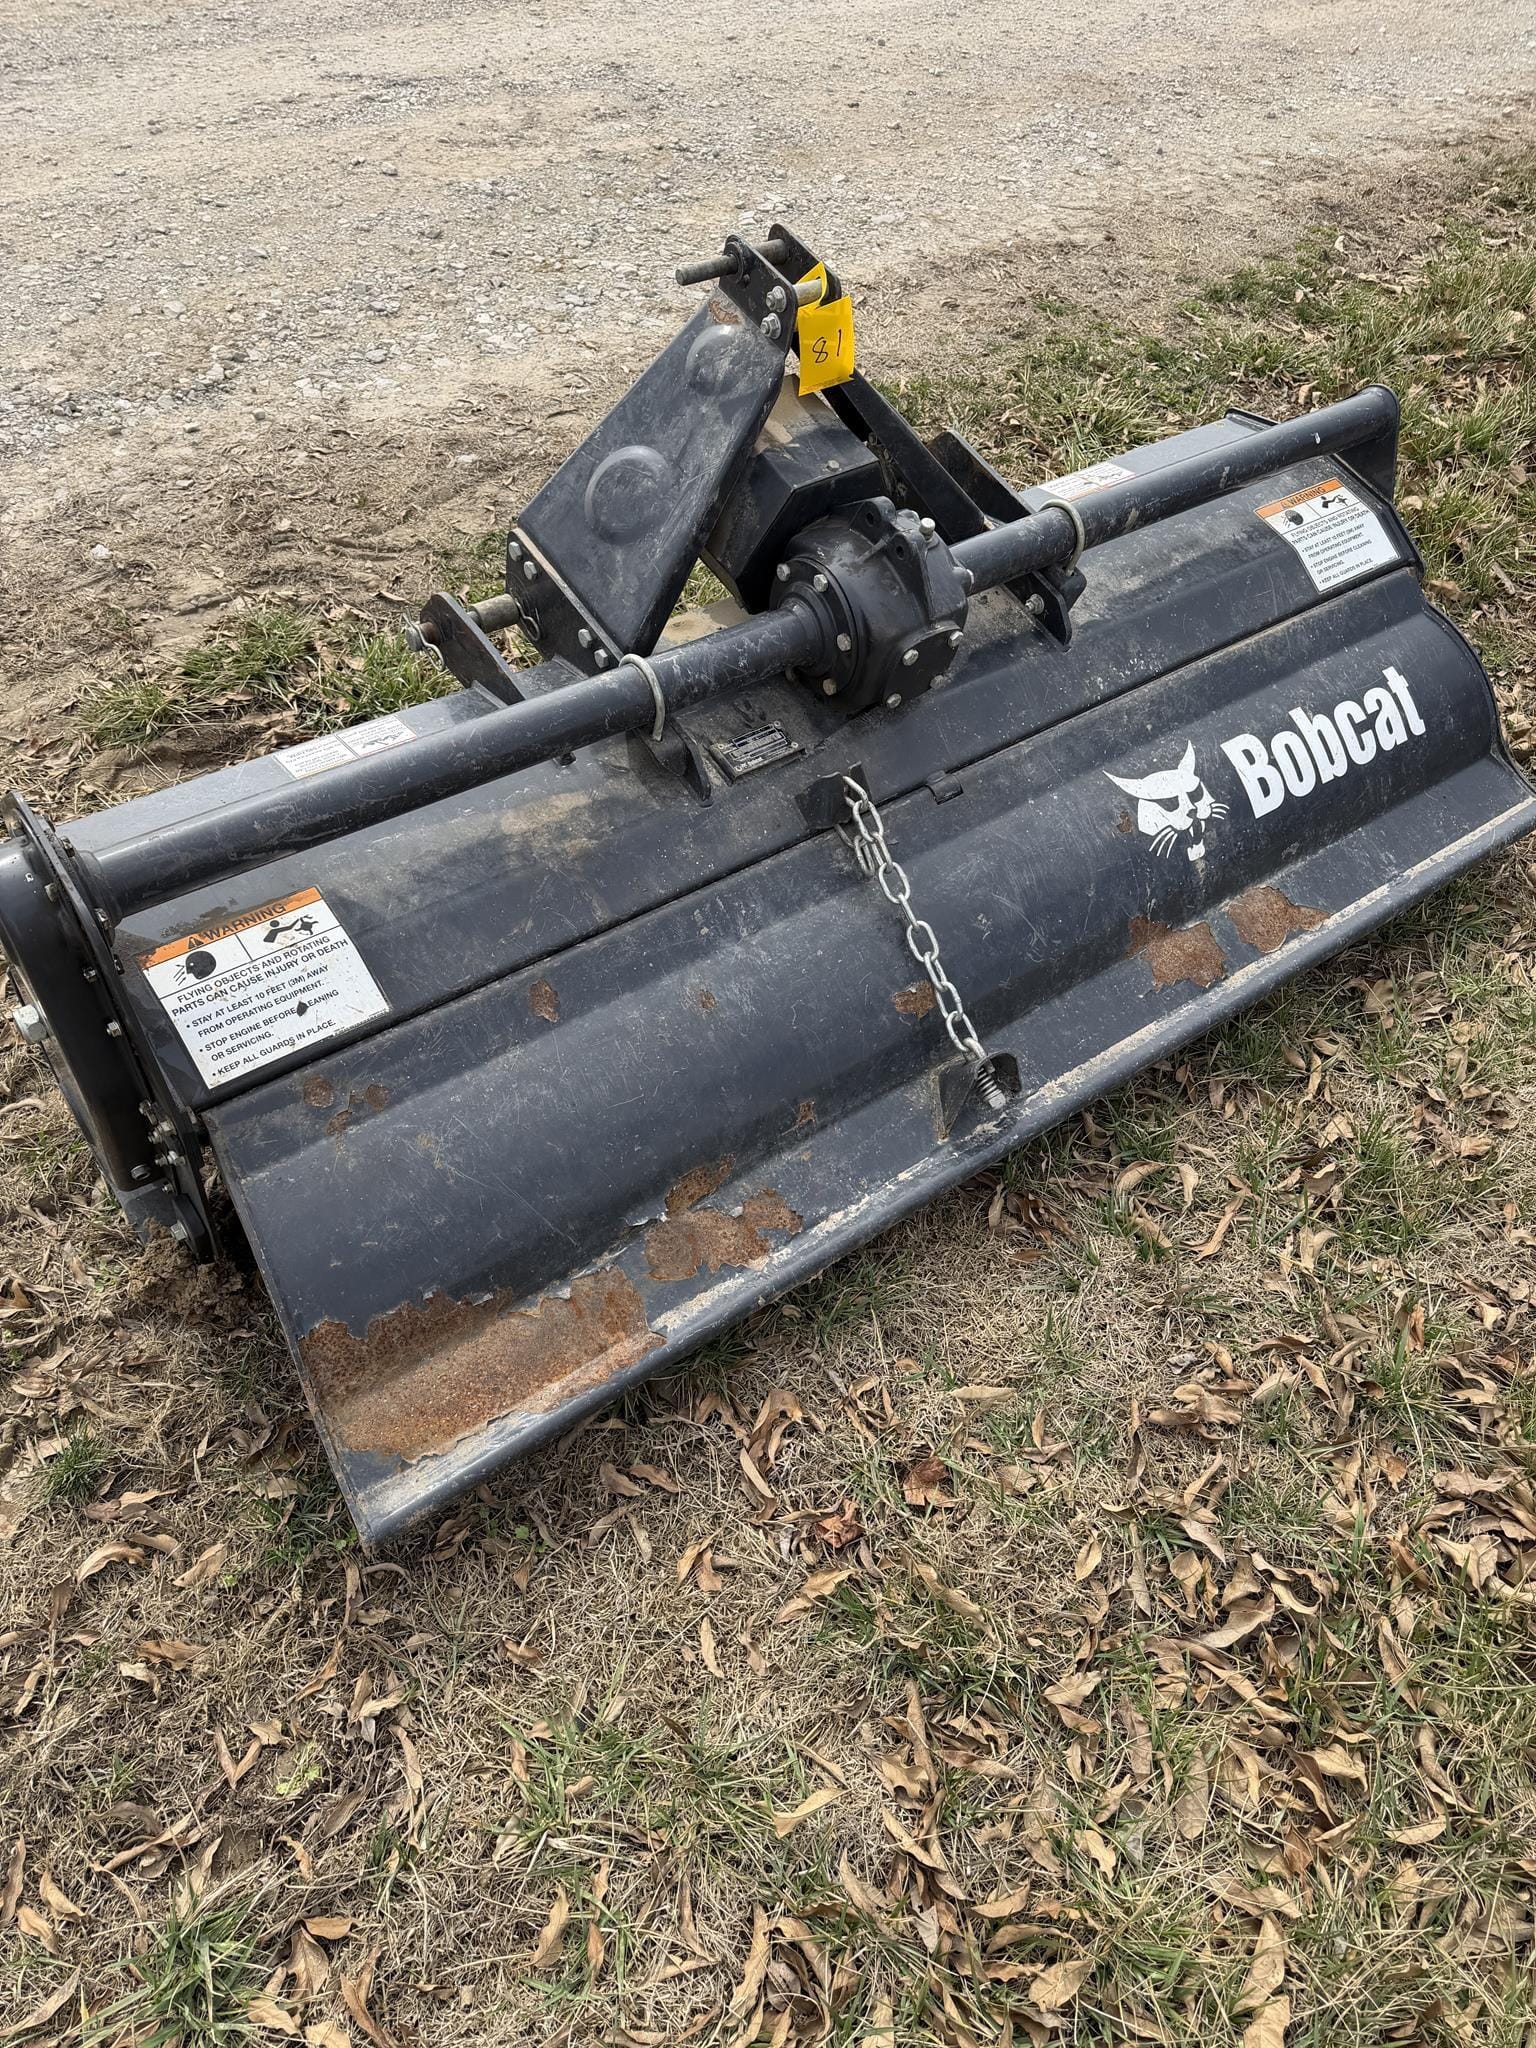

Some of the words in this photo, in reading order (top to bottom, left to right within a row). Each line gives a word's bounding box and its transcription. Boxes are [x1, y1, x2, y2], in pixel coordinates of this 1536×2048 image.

[812, 328, 842, 364] 81
[1286, 486, 1327, 506] WARNING
[1220, 666, 1427, 820] Bobcat
[202, 901, 288, 942] WARNING
[171, 997, 206, 1017] PARTS
[205, 988, 229, 1003] CAN
[228, 973, 265, 994] CAUSE
[263, 958, 301, 979] INJURY
[300, 951, 317, 964] OR
[315, 938, 349, 957] DEATH
[176, 983, 213, 1004] FLYING
[213, 964, 261, 989] OBJECTS
[260, 955, 283, 969] AND
[282, 935, 331, 960] ROTATING
[190, 1013, 214, 1028] STAY
[213, 1007, 228, 1018] AT
[226, 996, 255, 1013] LEAST
[254, 991, 266, 1001] 10
[265, 982, 288, 996] FEET
[286, 974, 306, 987] (3M)
[305, 964, 330, 980] AWAY
[197, 1021, 225, 1038] FROM
[224, 1000, 274, 1026] OPERATING
[273, 979, 326, 1006] EQUIPMENT.
[204, 1036, 229, 1052] STOP
[228, 1021, 262, 1041] ENGINE
[262, 1006, 297, 1027] BEFORE
[299, 988, 339, 1011] EANING
[210, 1050, 225, 1062] OR
[224, 1029, 274, 1055] SERVICING.
[216, 1059, 242, 1076] KEEP
[241, 1052, 260, 1065] ALL
[258, 1036, 296, 1057] GUARDS
[294, 1031, 306, 1041] IN
[305, 1018, 336, 1037] PLACE.
